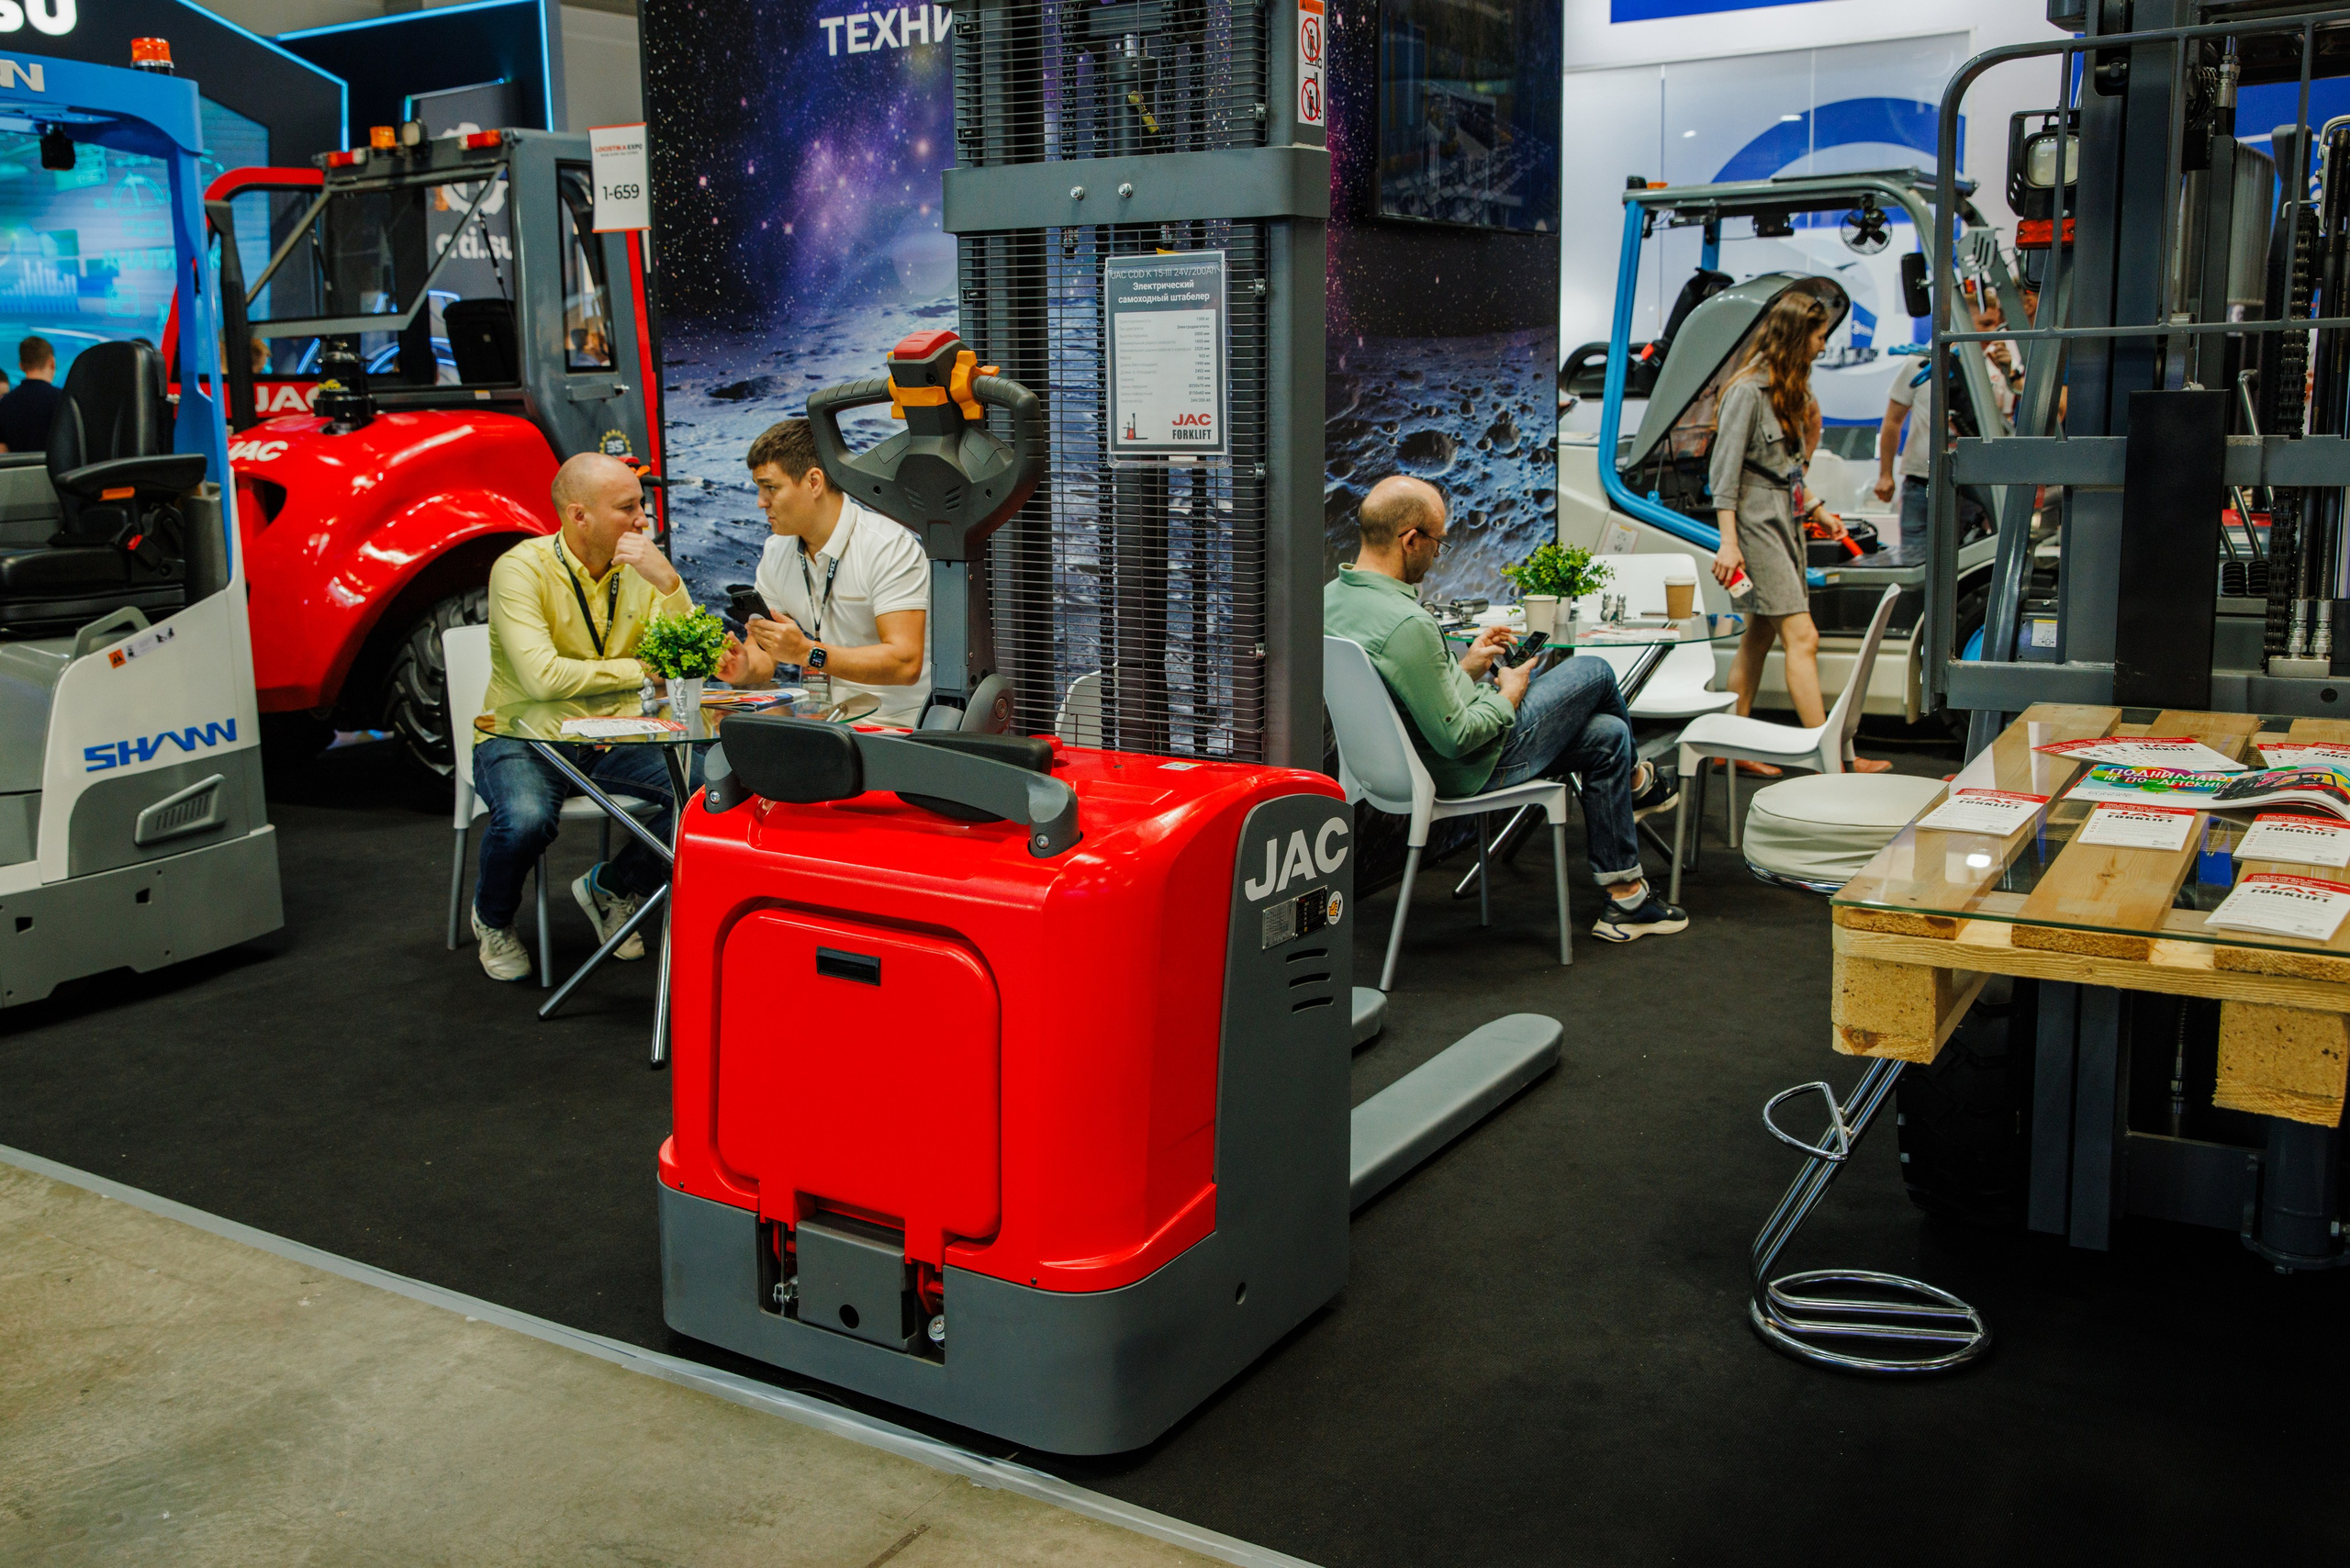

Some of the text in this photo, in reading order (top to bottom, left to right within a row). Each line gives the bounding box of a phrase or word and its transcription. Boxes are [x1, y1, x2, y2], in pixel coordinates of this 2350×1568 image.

[820, 5, 953, 57] ТЕХНИ
[602, 184, 641, 201] 1-659
[1111, 271, 1126, 280] JAC
[1128, 269, 1145, 279] CDD
[1133, 279, 1194, 291] Электрический
[1118, 292, 1210, 304] самоходный штабелер
[1171, 413, 1212, 426] JAC
[1172, 429, 1212, 440] FORKLIFT
[606, 440, 624, 454] 35
[1958, 800, 2021, 809] FORKLIFT
[1963, 797, 2024, 805] JAC
[2107, 814, 2175, 823] FORKLIFT
[2266, 826, 2339, 837] FORKLIFT
[2267, 823, 2340, 833] JAC
[1245, 816, 1349, 902] JAC
[2250, 889, 2333, 903] FORKLIFT
[2255, 884, 2335, 898] JAC
